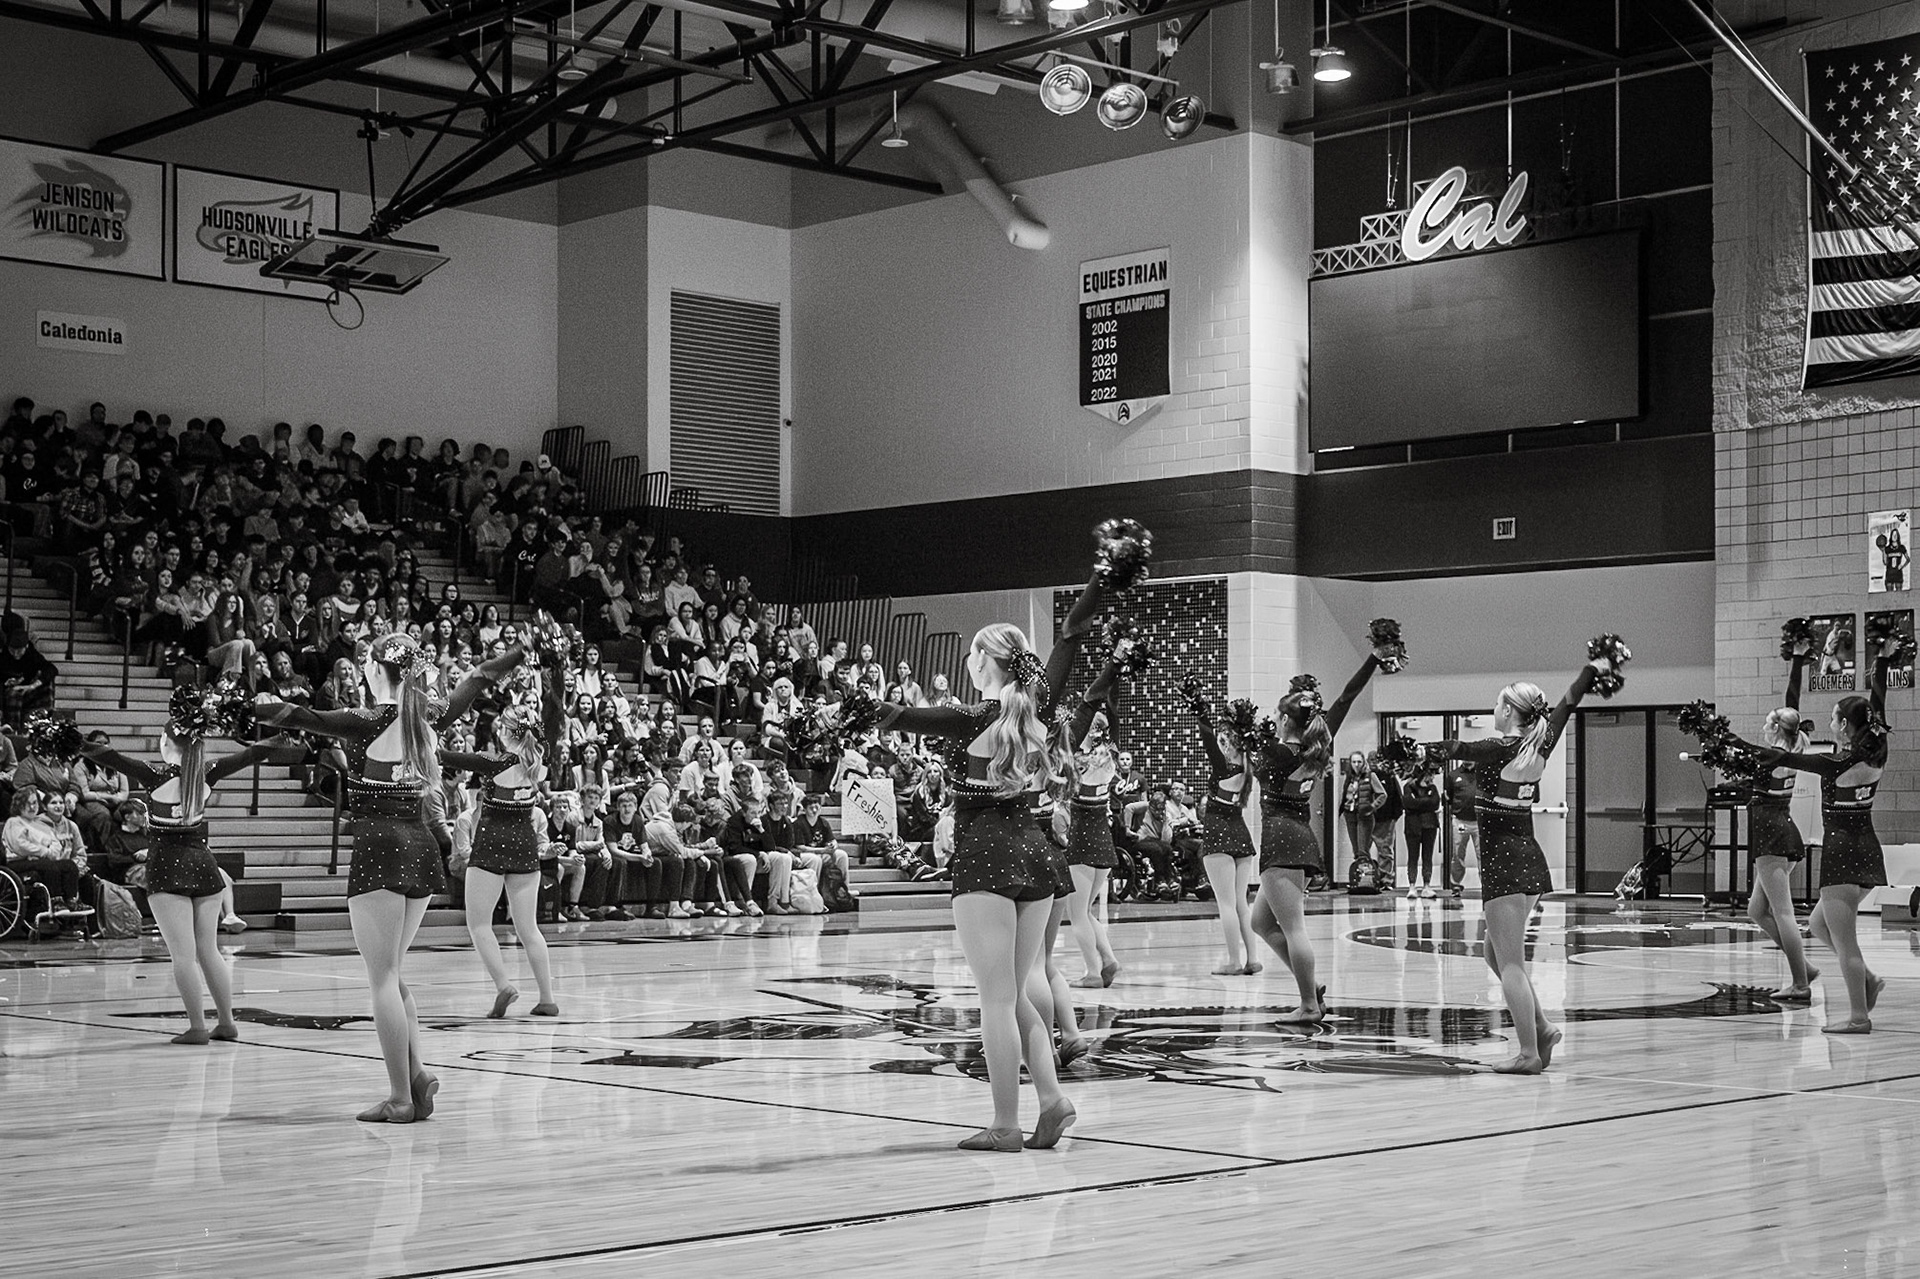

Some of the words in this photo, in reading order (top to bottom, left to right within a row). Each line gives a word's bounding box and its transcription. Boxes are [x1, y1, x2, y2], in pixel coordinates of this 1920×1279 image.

[40, 182, 115, 212] JENISON
[32, 208, 123, 241] WILDCATS
[202, 206, 313, 241] HUDSONVILLE
[1402, 166, 1529, 262] Cal
[225, 235, 292, 262] EAGLES
[1083, 260, 1168, 293] EQUESTRIAN
[1086, 303, 1112, 320] STATE
[1114, 293, 1166, 315] CHAMPIONS
[39, 320, 123, 346] Caledonia
[1091, 320, 1118, 336] 2002
[1091, 336, 1117, 352] 2015
[1091, 353, 1118, 368] 2020
[1091, 368, 1117, 383] 2021
[1090, 386, 1117, 402] 2022
[1497, 520, 1514, 536] EXIT
[1811, 674, 1855, 691] BLOEMERS
[1115, 779, 1141, 797] Cal
[846, 780, 888, 829] Freshies
